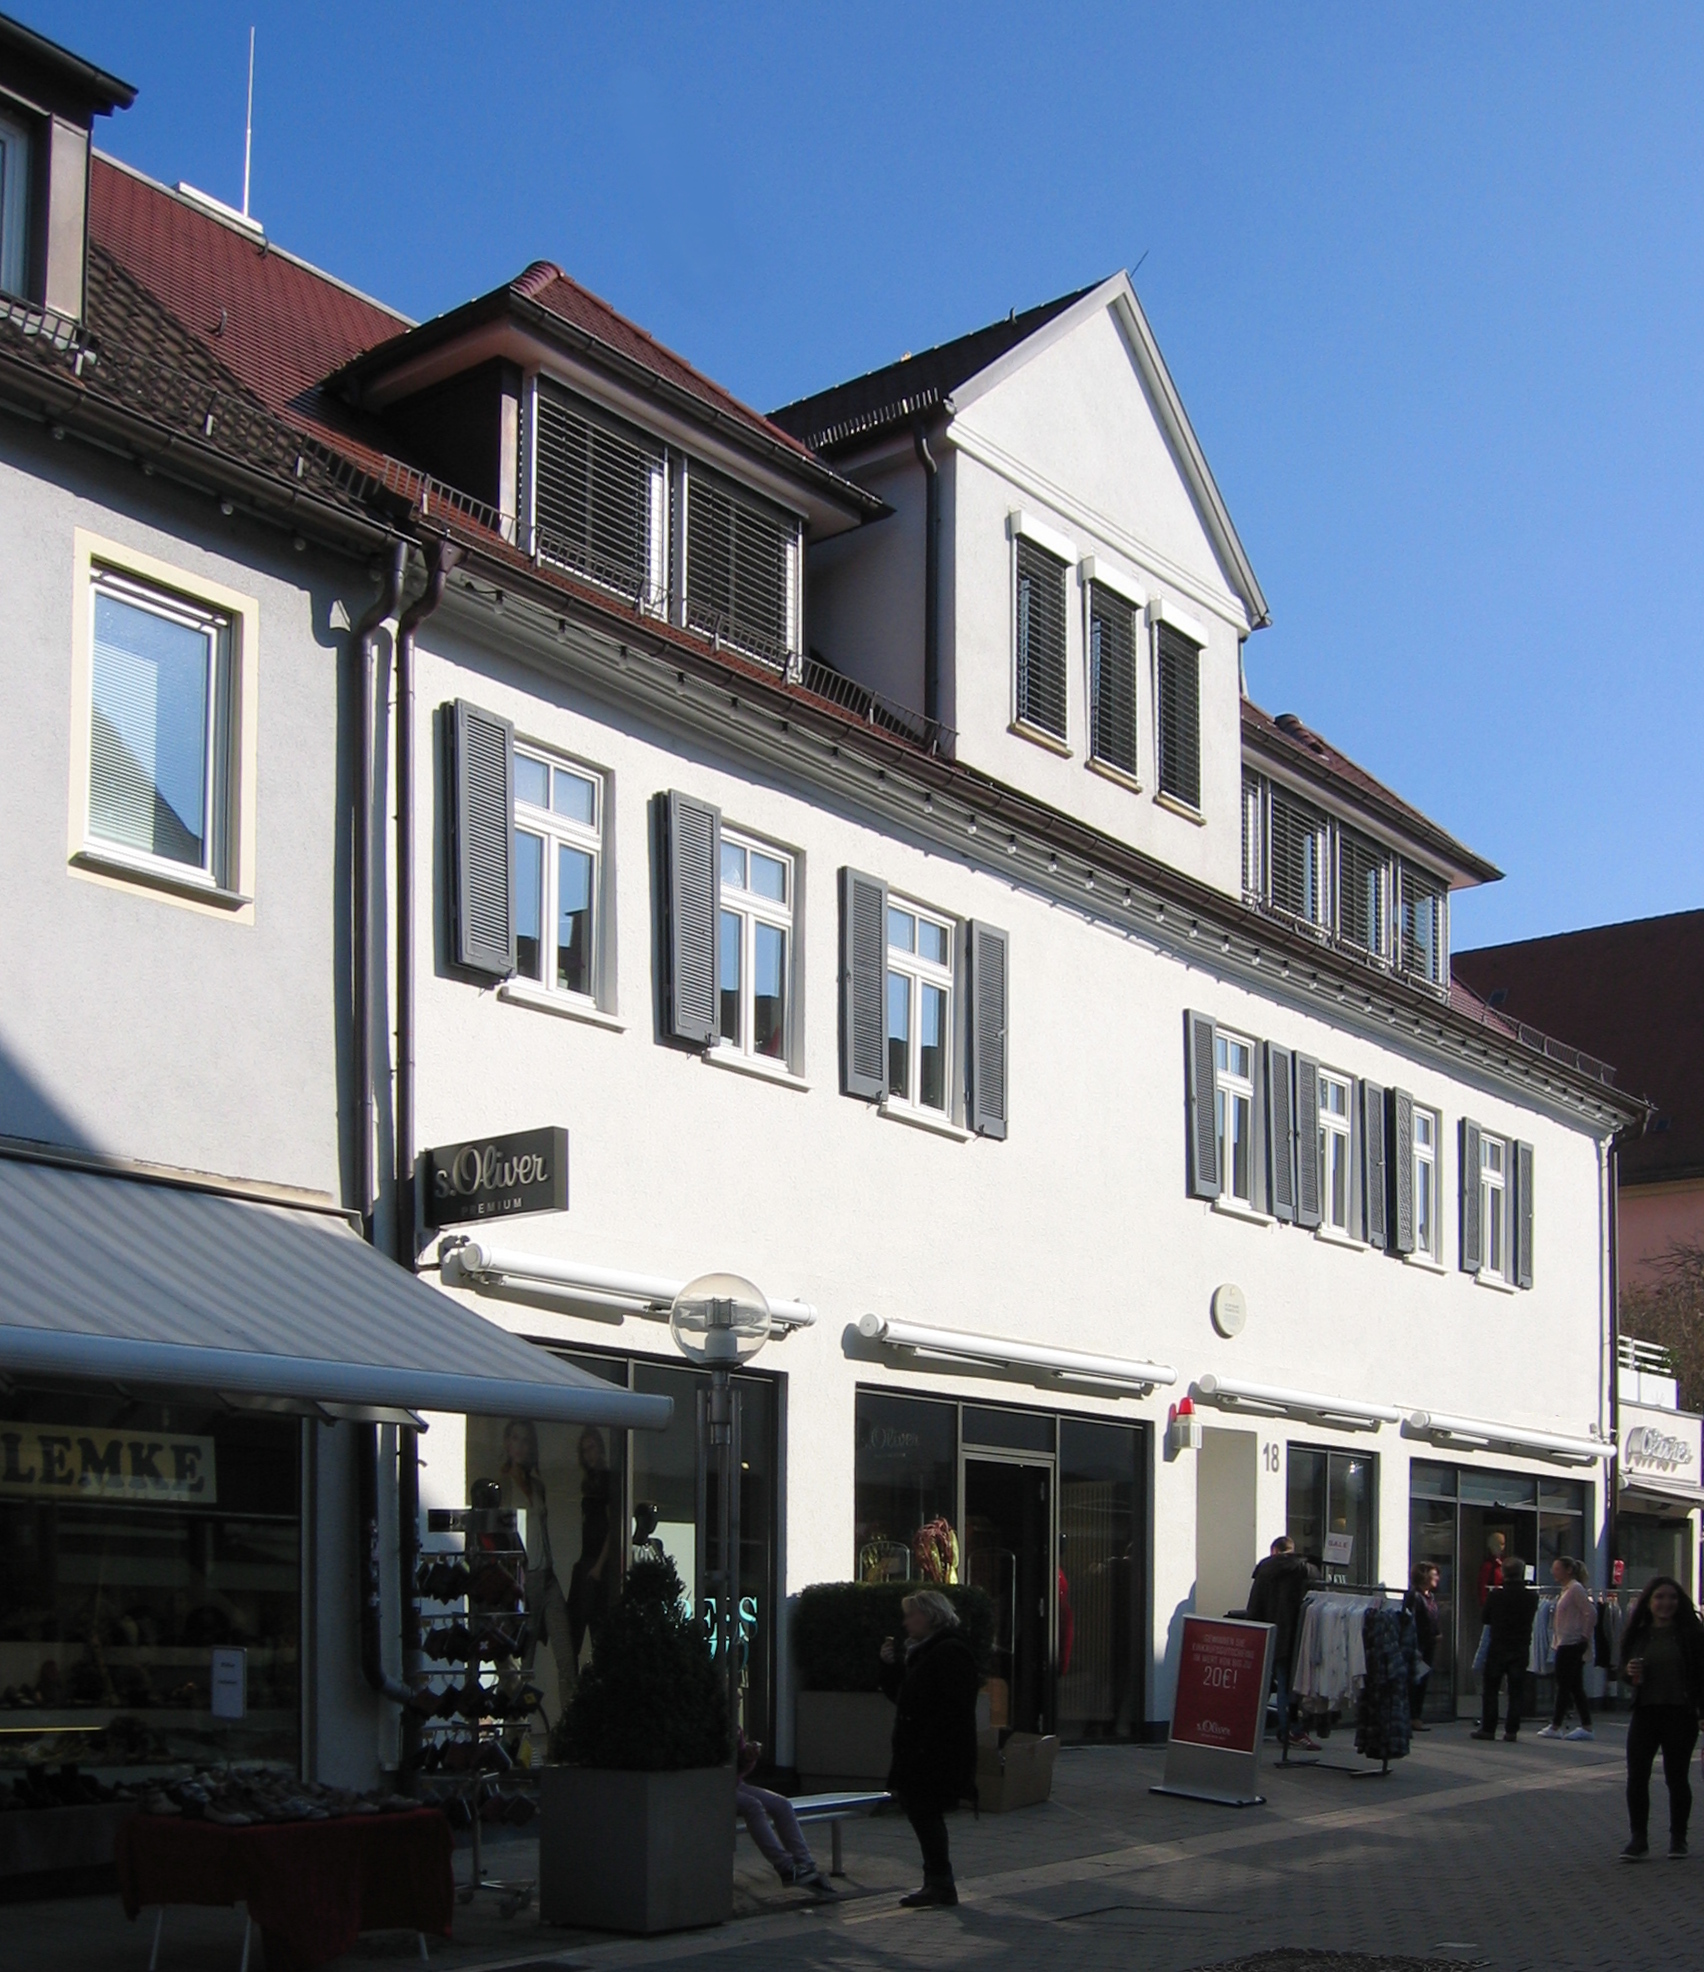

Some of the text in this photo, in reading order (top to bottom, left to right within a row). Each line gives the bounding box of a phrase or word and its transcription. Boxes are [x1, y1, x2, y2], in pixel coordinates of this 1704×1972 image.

[434, 1144, 549, 1199] s.Oliver
[0, 1432, 205, 1493] LEMKE
[1263, 1442, 1280, 1473] 18
[1203, 1665, 1238, 1689] 20€!
